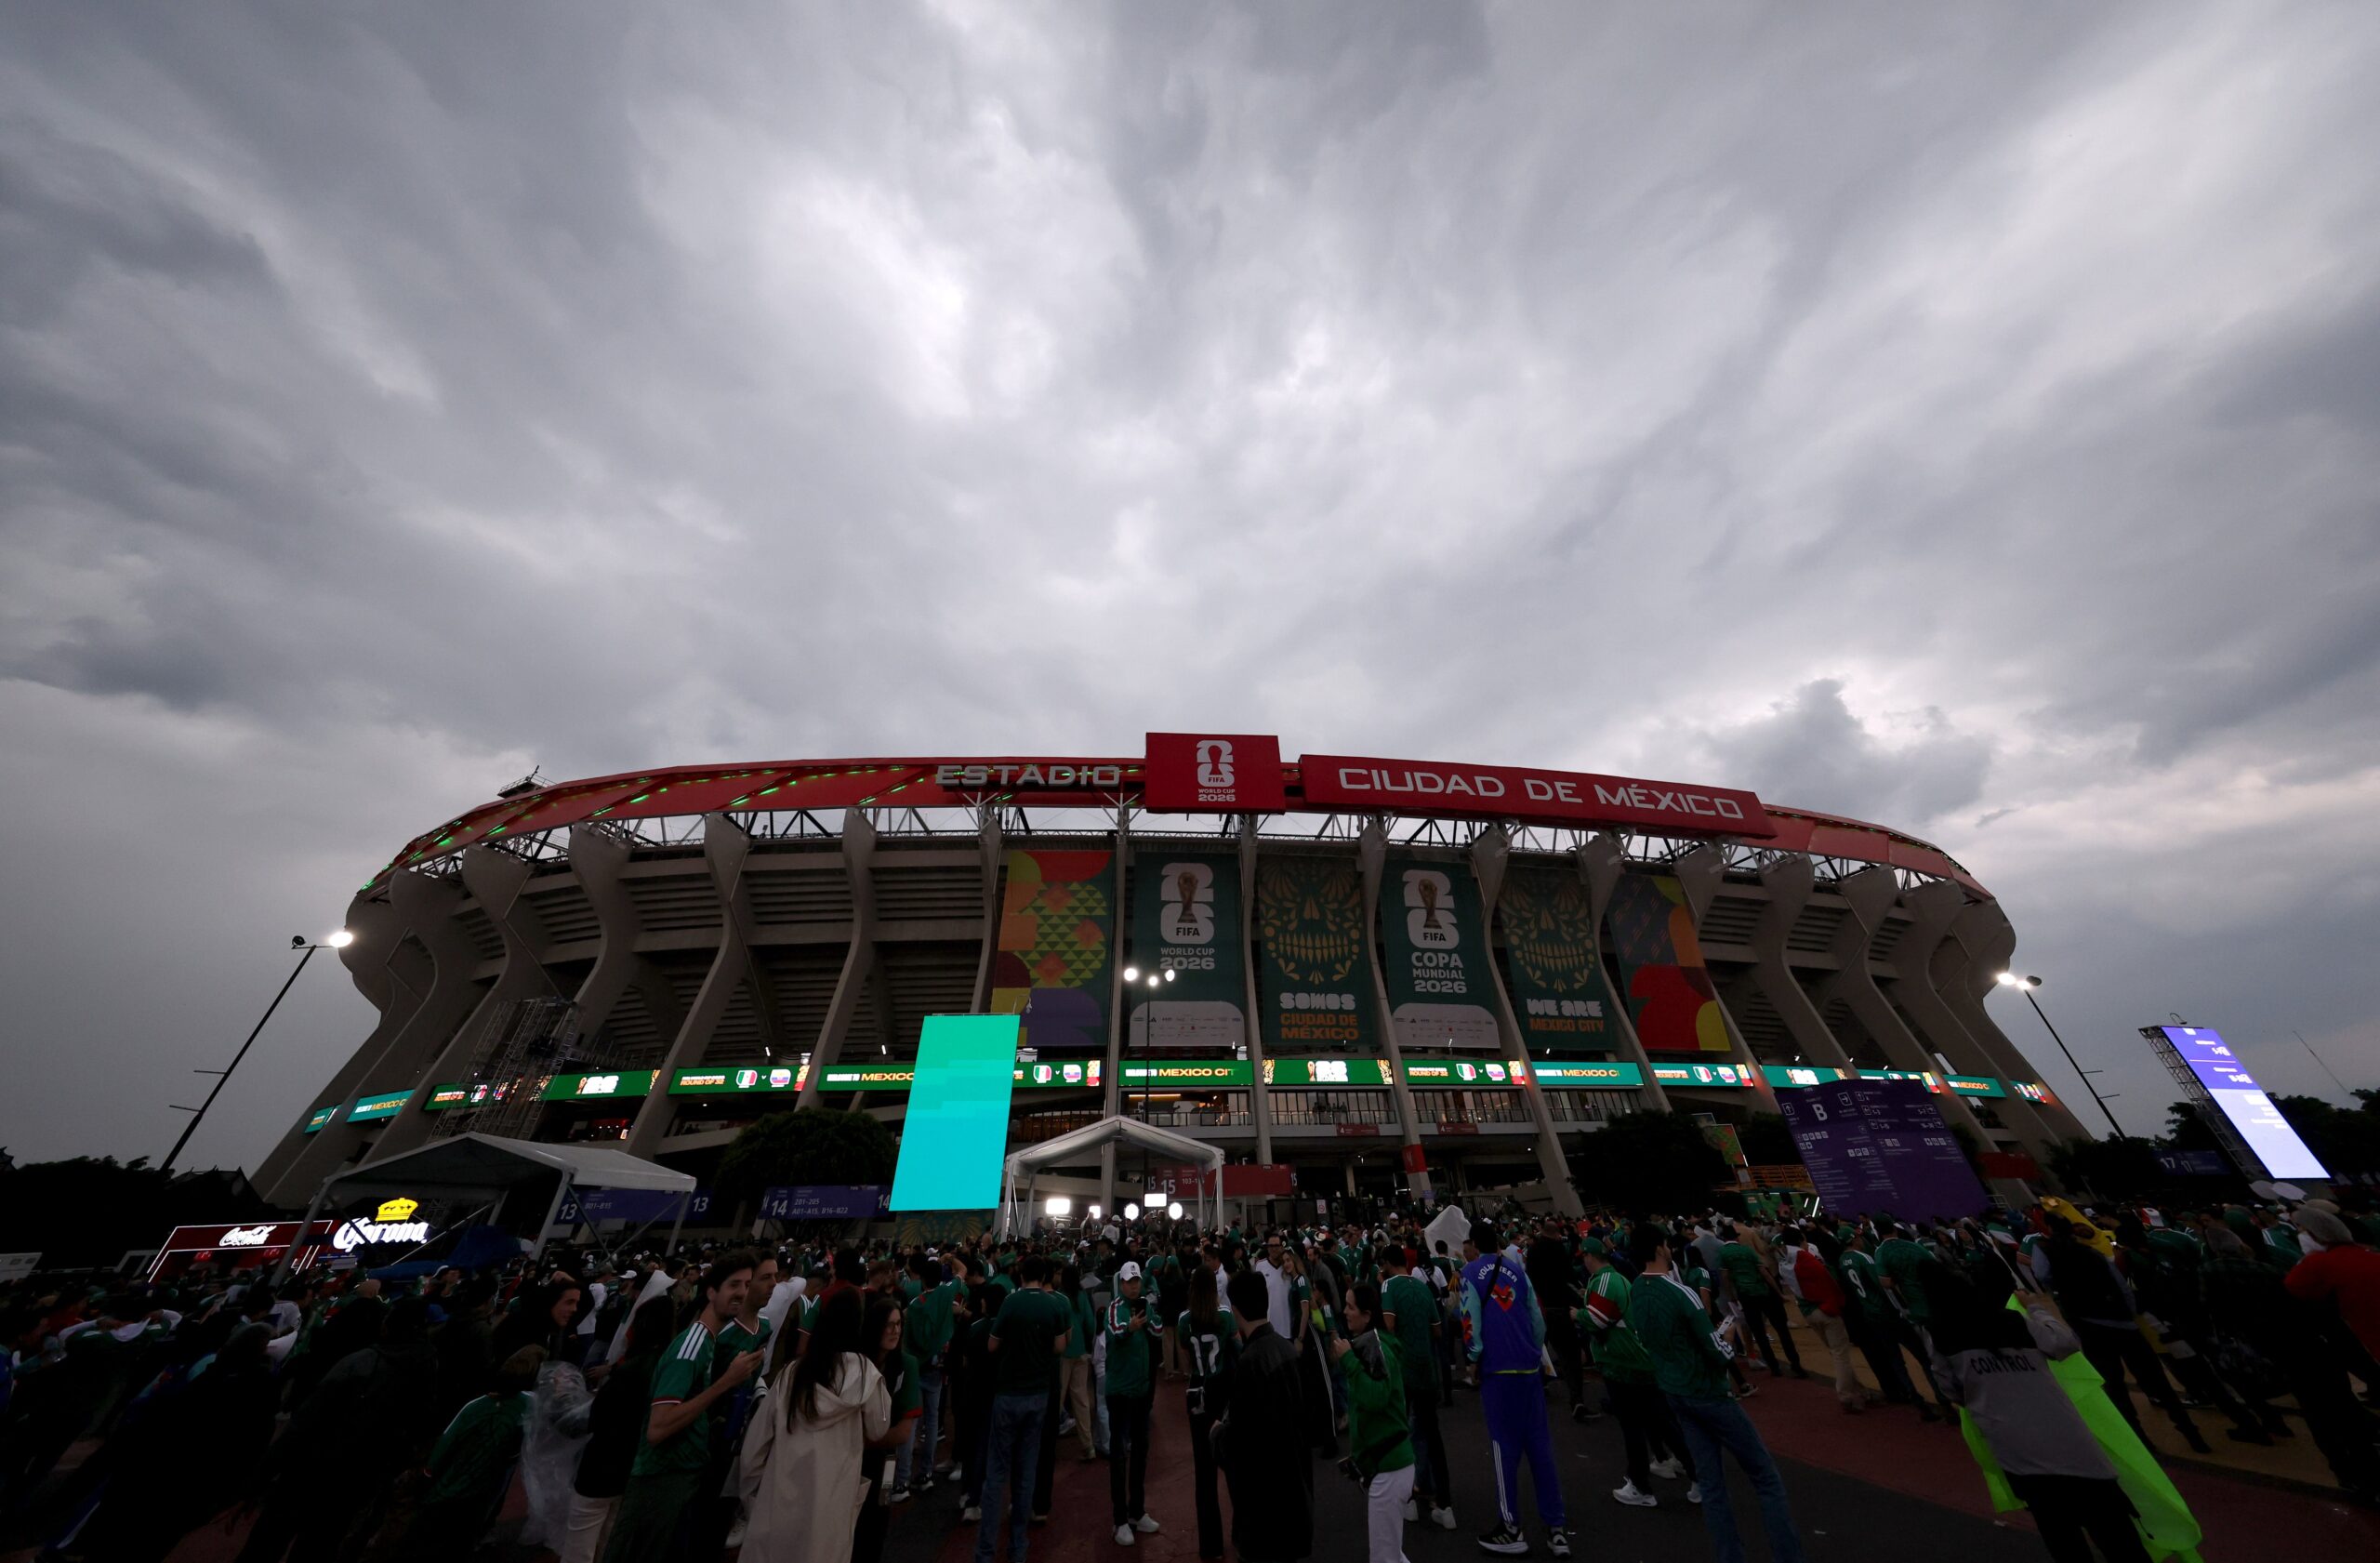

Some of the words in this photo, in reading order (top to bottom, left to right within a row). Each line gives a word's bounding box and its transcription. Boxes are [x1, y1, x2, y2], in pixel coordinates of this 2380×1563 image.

[935, 765, 1120, 787] ESTADIO
[1197, 793, 1236, 802] 2026
[1339, 768, 1505, 797] CIUDAD
[1524, 778, 1582, 802] DE
[1594, 784, 1744, 819] MÉXICO
[1175, 927, 1200, 937] FIFA
[1423, 932, 1447, 942] FIFA
[1160, 947, 1195, 957] WORLD
[1196, 947, 1215, 957] CUP
[1159, 957, 1216, 970] 2026
[1410, 951, 1464, 969] COPA
[1412, 968, 1465, 980] MUNDIAL
[1414, 980, 1467, 994] 2026
[1279, 992, 1356, 1011] SOMOS
[1526, 998, 1559, 1016] WE
[1560, 999, 1604, 1017] ARE
[1279, 1013, 1337, 1026] CIUDAD
[1338, 1013, 1358, 1027] DE
[1529, 1018, 1577, 1032] MEXICO
[1577, 1019, 1605, 1033] CITY
[1280, 1026, 1360, 1040] MÉXICO
[1158, 1068, 1212, 1077] MEXICO
[1812, 1103, 1829, 1121] B
[2159, 1157, 2175, 1169] 17
[1147, 1175, 1157, 1191] 15
[1290, 1172, 1298, 1186] 15
[1161, 1179, 1176, 1195] 15
[693, 1197, 709, 1212] 13
[771, 1199, 788, 1217] 14
[878, 1194, 890, 1209] 14
[560, 1203, 578, 1220] 13
[1847, 1268, 1867, 1298] 9
[1190, 1333, 1220, 1377] 17
[1970, 1355, 2036, 1374] CONTROL
